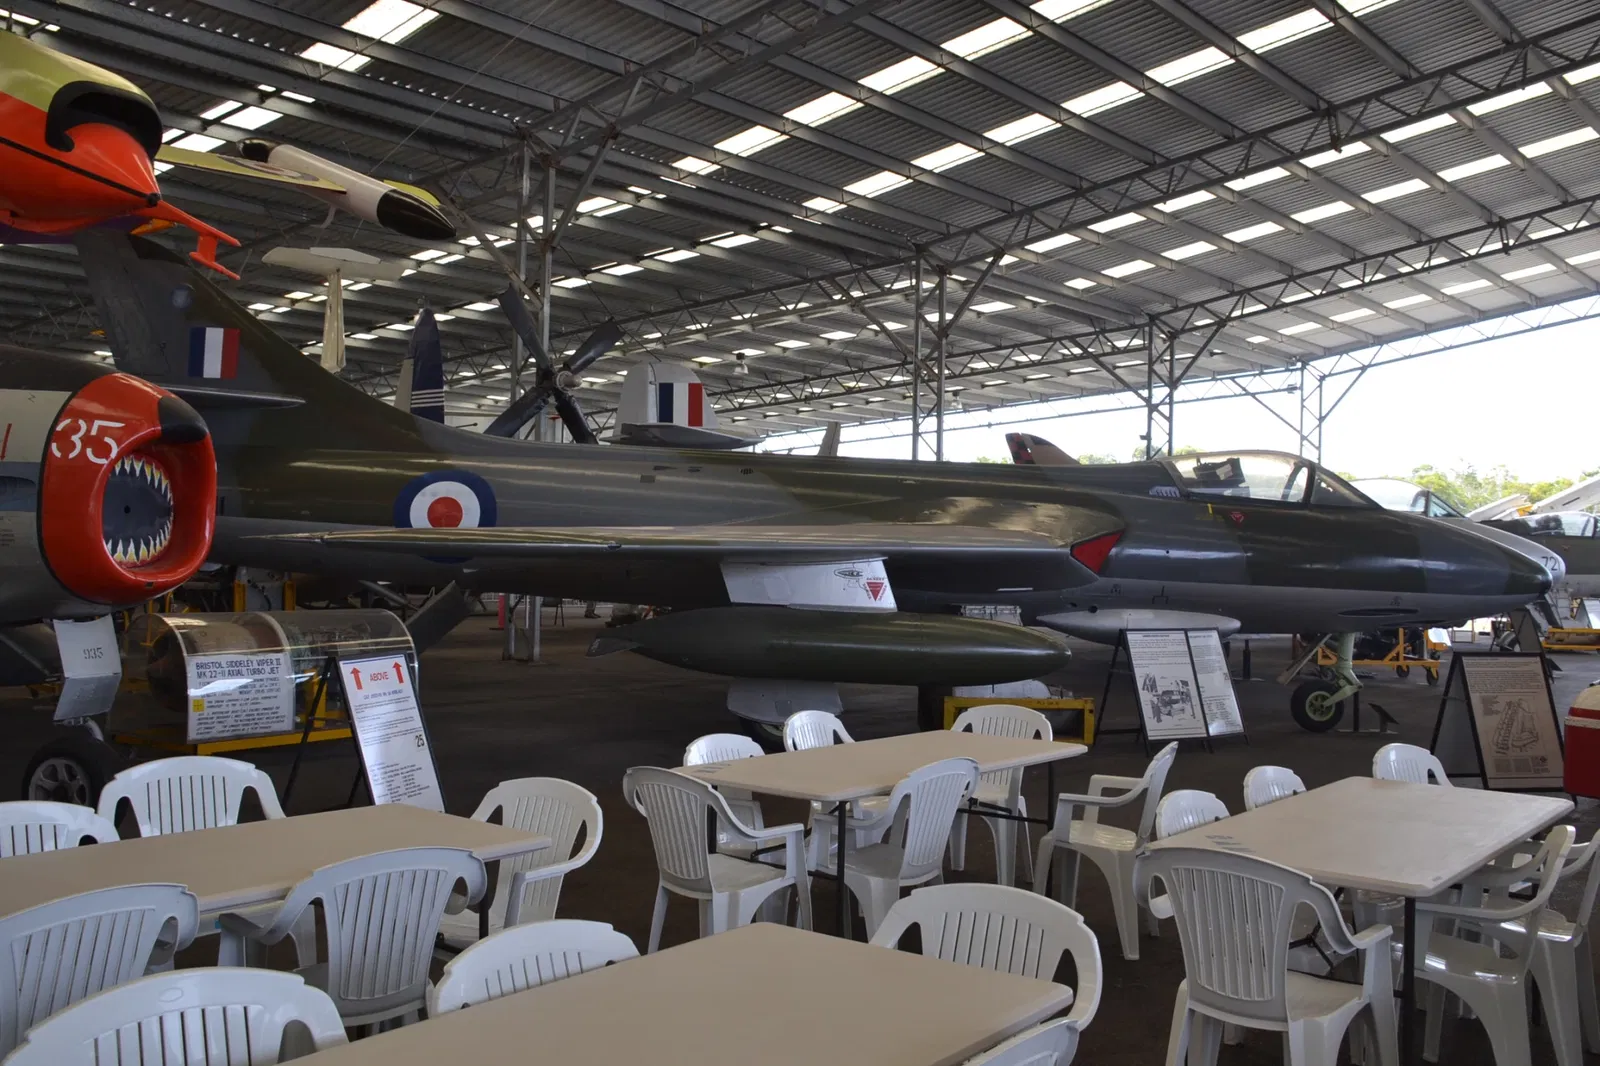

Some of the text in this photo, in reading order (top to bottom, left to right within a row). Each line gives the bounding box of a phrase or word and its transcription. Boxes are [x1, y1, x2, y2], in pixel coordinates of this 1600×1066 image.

[51, 418, 126, 464] 35
[83, 647, 104, 660] 935
[196, 661, 224, 670] BRISTOL
[226, 660, 254, 669] SIDDELEY
[256, 658, 274, 667] VIPER
[227, 668, 245, 677] AXIAL
[246, 667, 266, 676] TURBO
[267, 666, 280, 675] JET
[369, 671, 389, 682] ABOVE
[415, 734, 425, 748] 25
